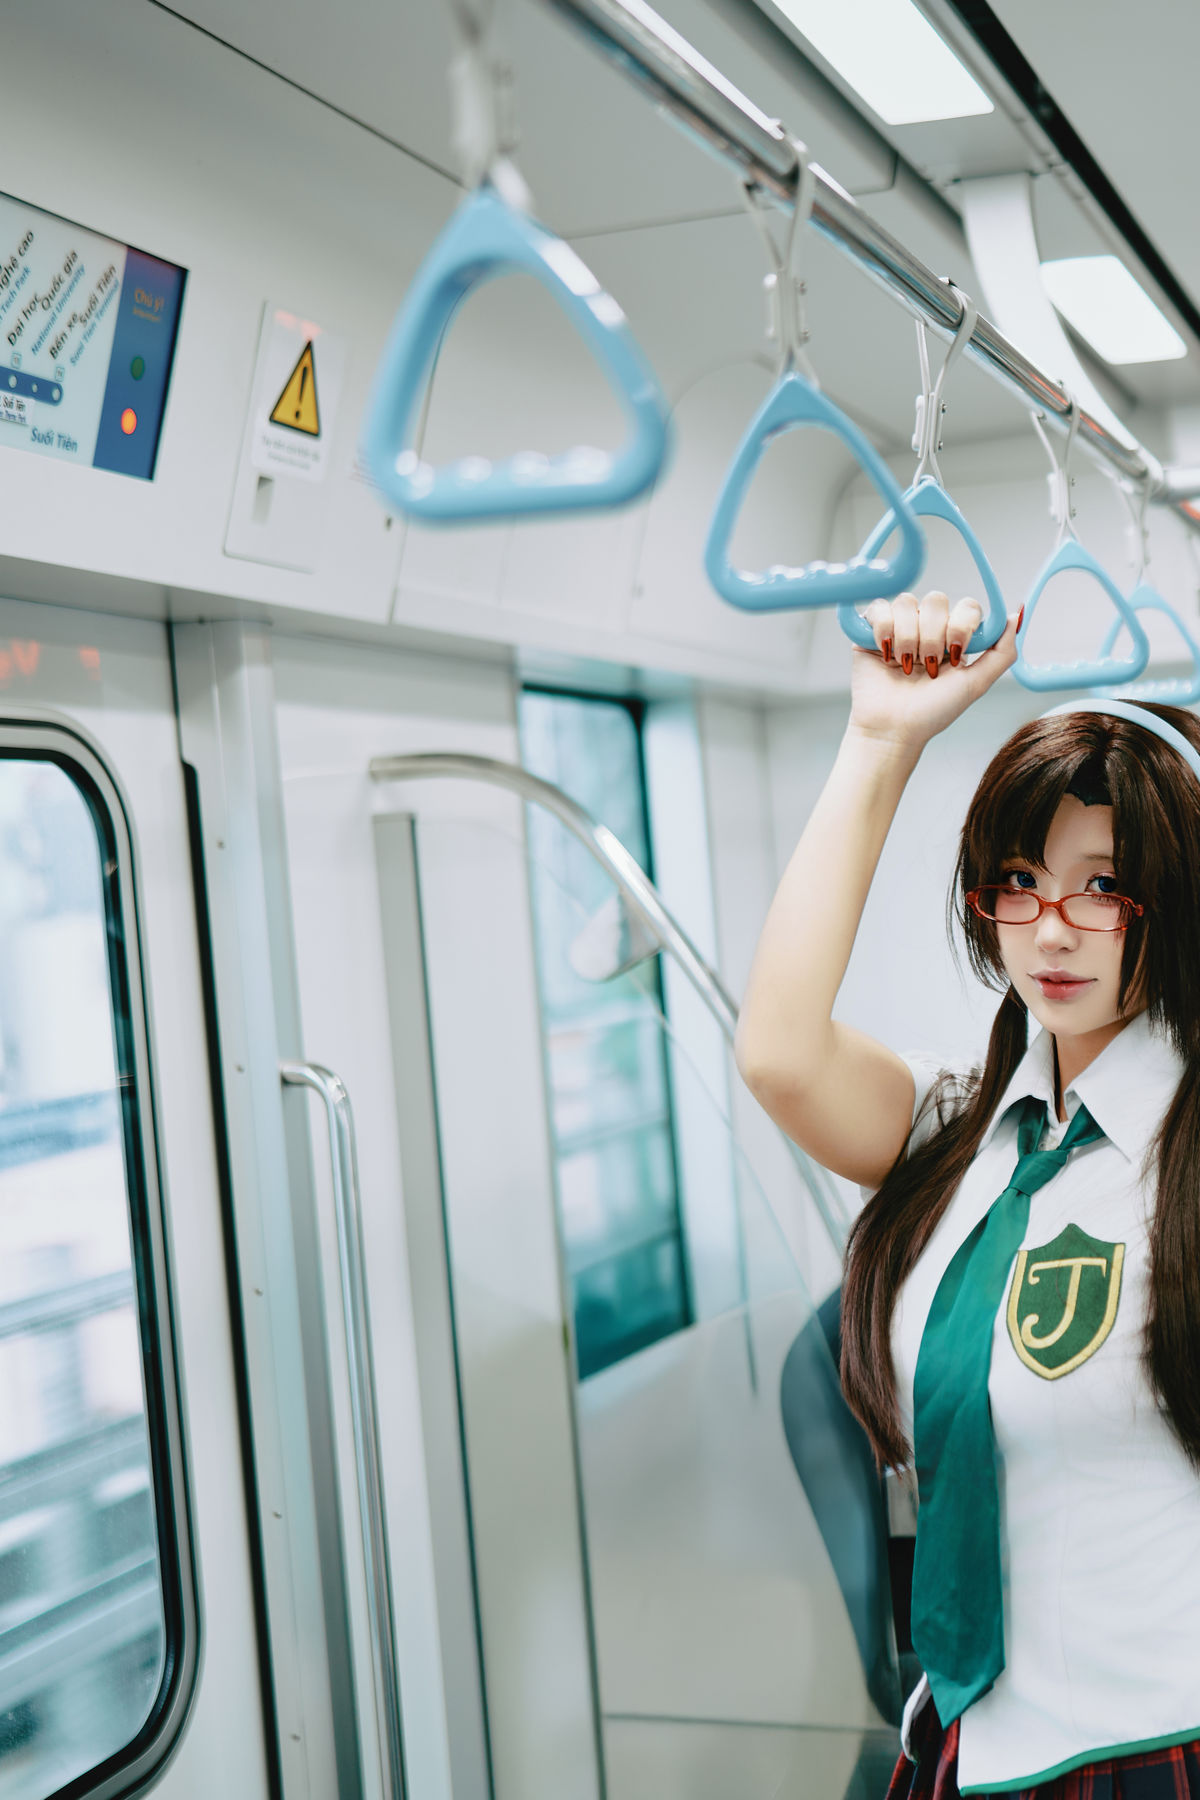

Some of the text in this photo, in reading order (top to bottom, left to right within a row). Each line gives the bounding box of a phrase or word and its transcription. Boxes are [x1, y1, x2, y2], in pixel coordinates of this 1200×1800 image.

[18, 231, 34, 257] cao
[64, 249, 78, 276] gia
[15, 266, 31, 290] Park
[31, 264, 85, 356] National University
[31, 427, 54, 446] Suối
[1021, 1257, 1107, 1349] J
